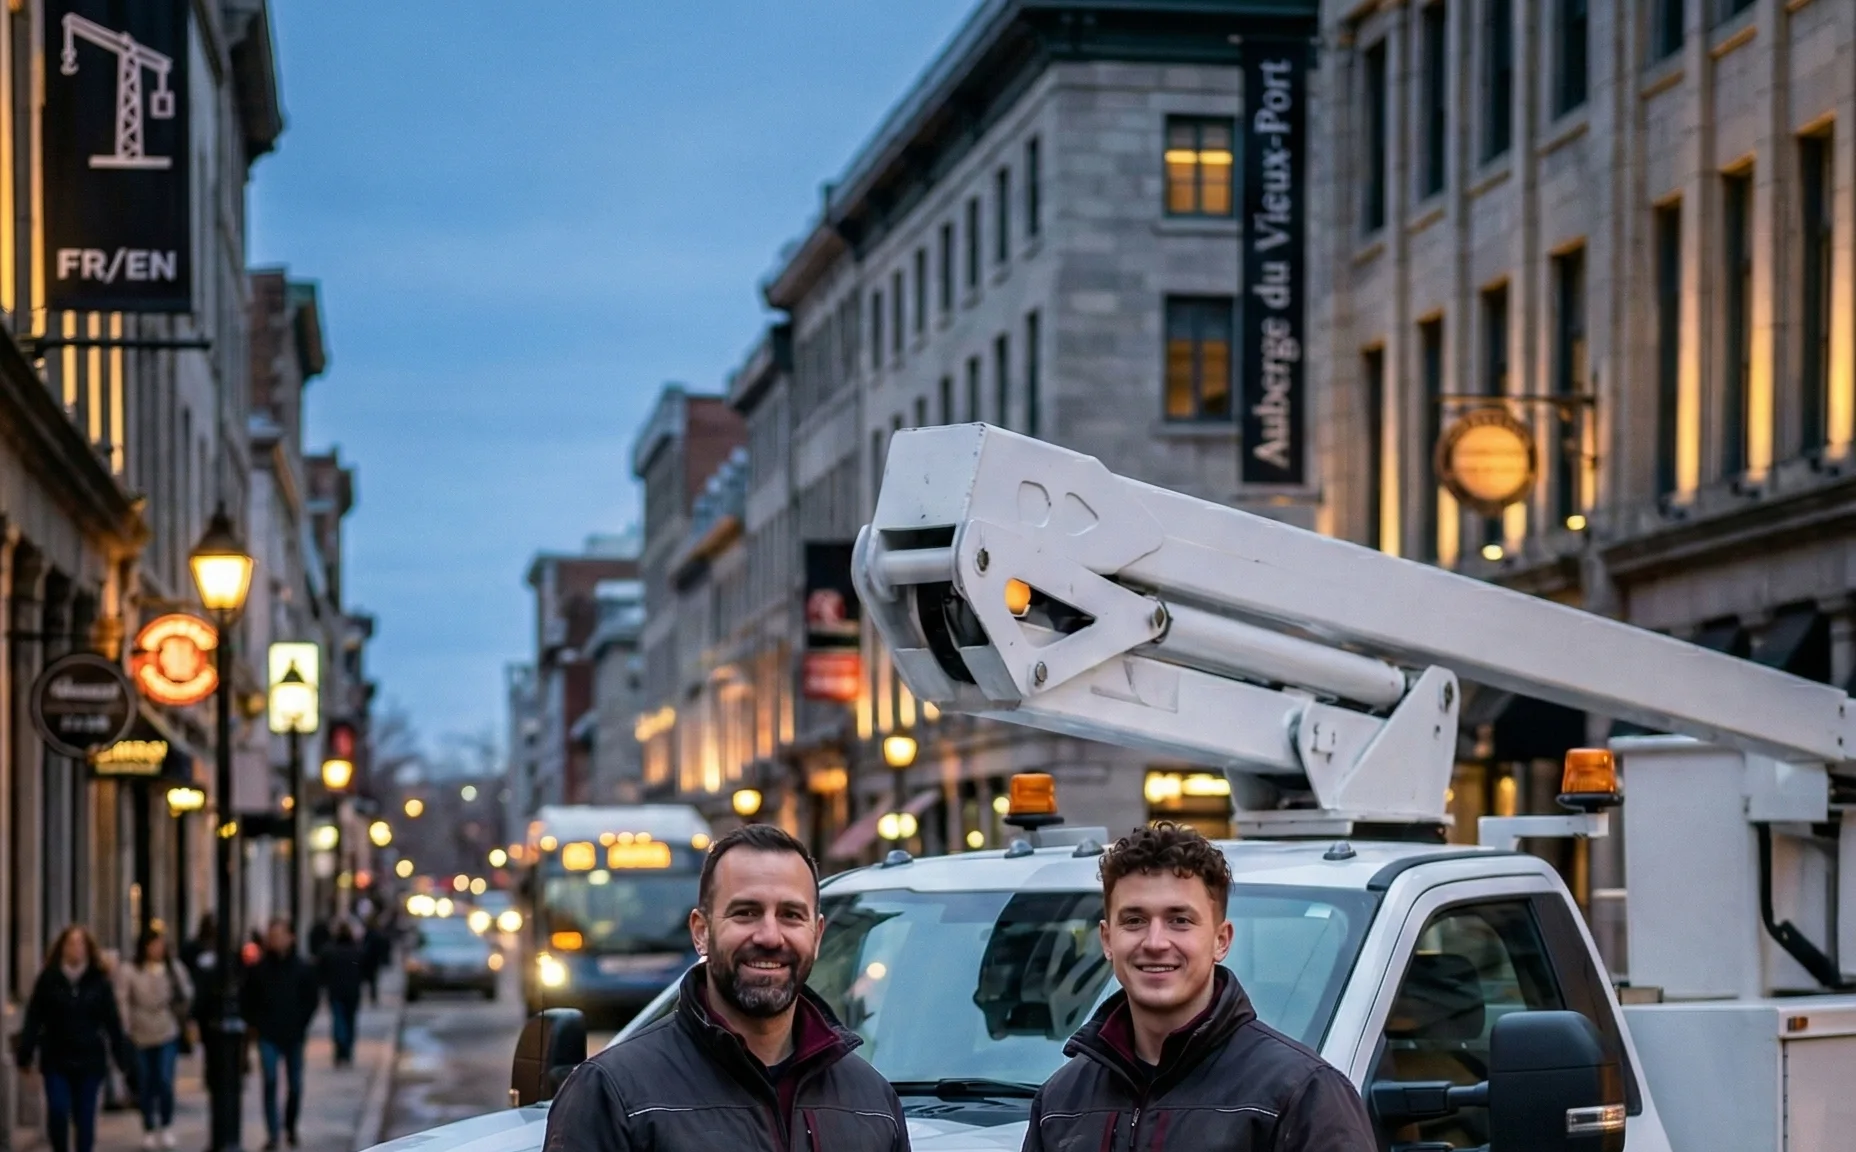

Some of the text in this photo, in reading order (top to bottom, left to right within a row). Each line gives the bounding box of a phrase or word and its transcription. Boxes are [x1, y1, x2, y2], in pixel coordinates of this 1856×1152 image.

[57, 248, 177, 283] FR/EN
[1252, 59, 1299, 469] Auberge du Vieux-Port
